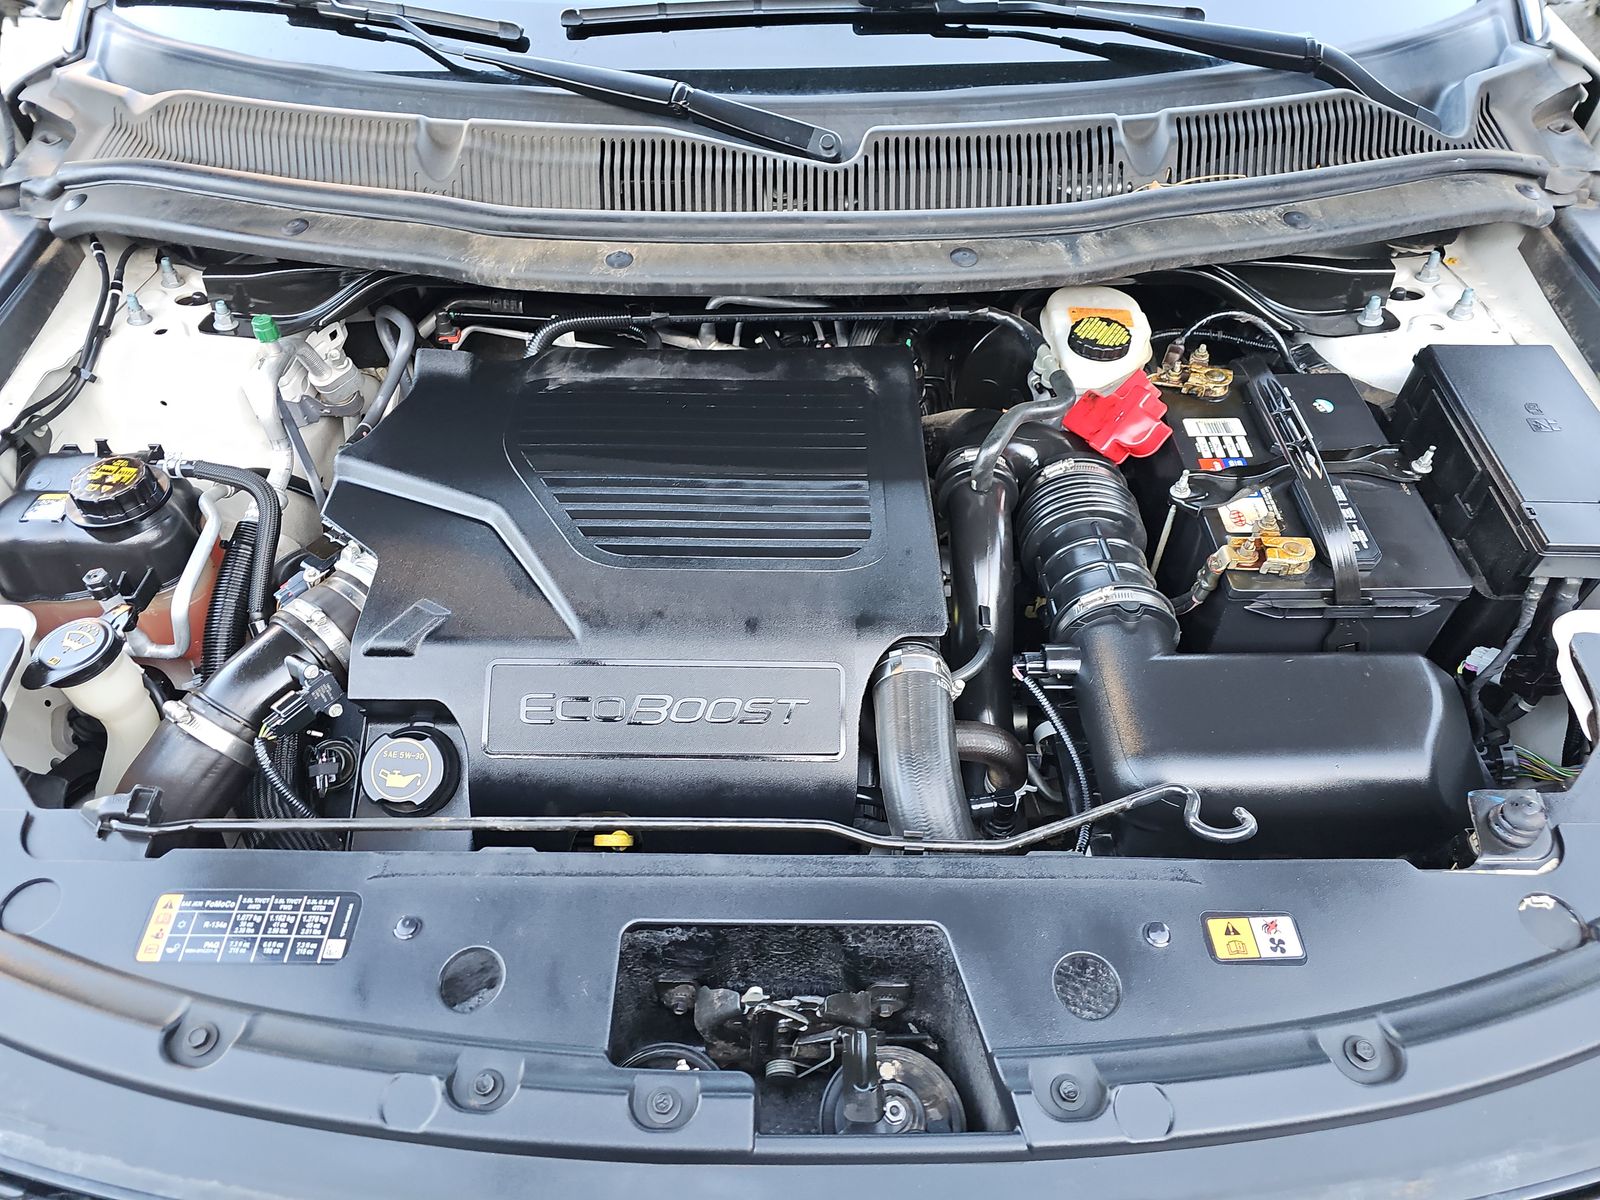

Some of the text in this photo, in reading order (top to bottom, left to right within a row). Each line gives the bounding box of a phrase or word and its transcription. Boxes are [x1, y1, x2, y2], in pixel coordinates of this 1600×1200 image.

[383, 750, 425, 761] SAE 5W-30
[204, 900, 236, 909] FoMoCo
